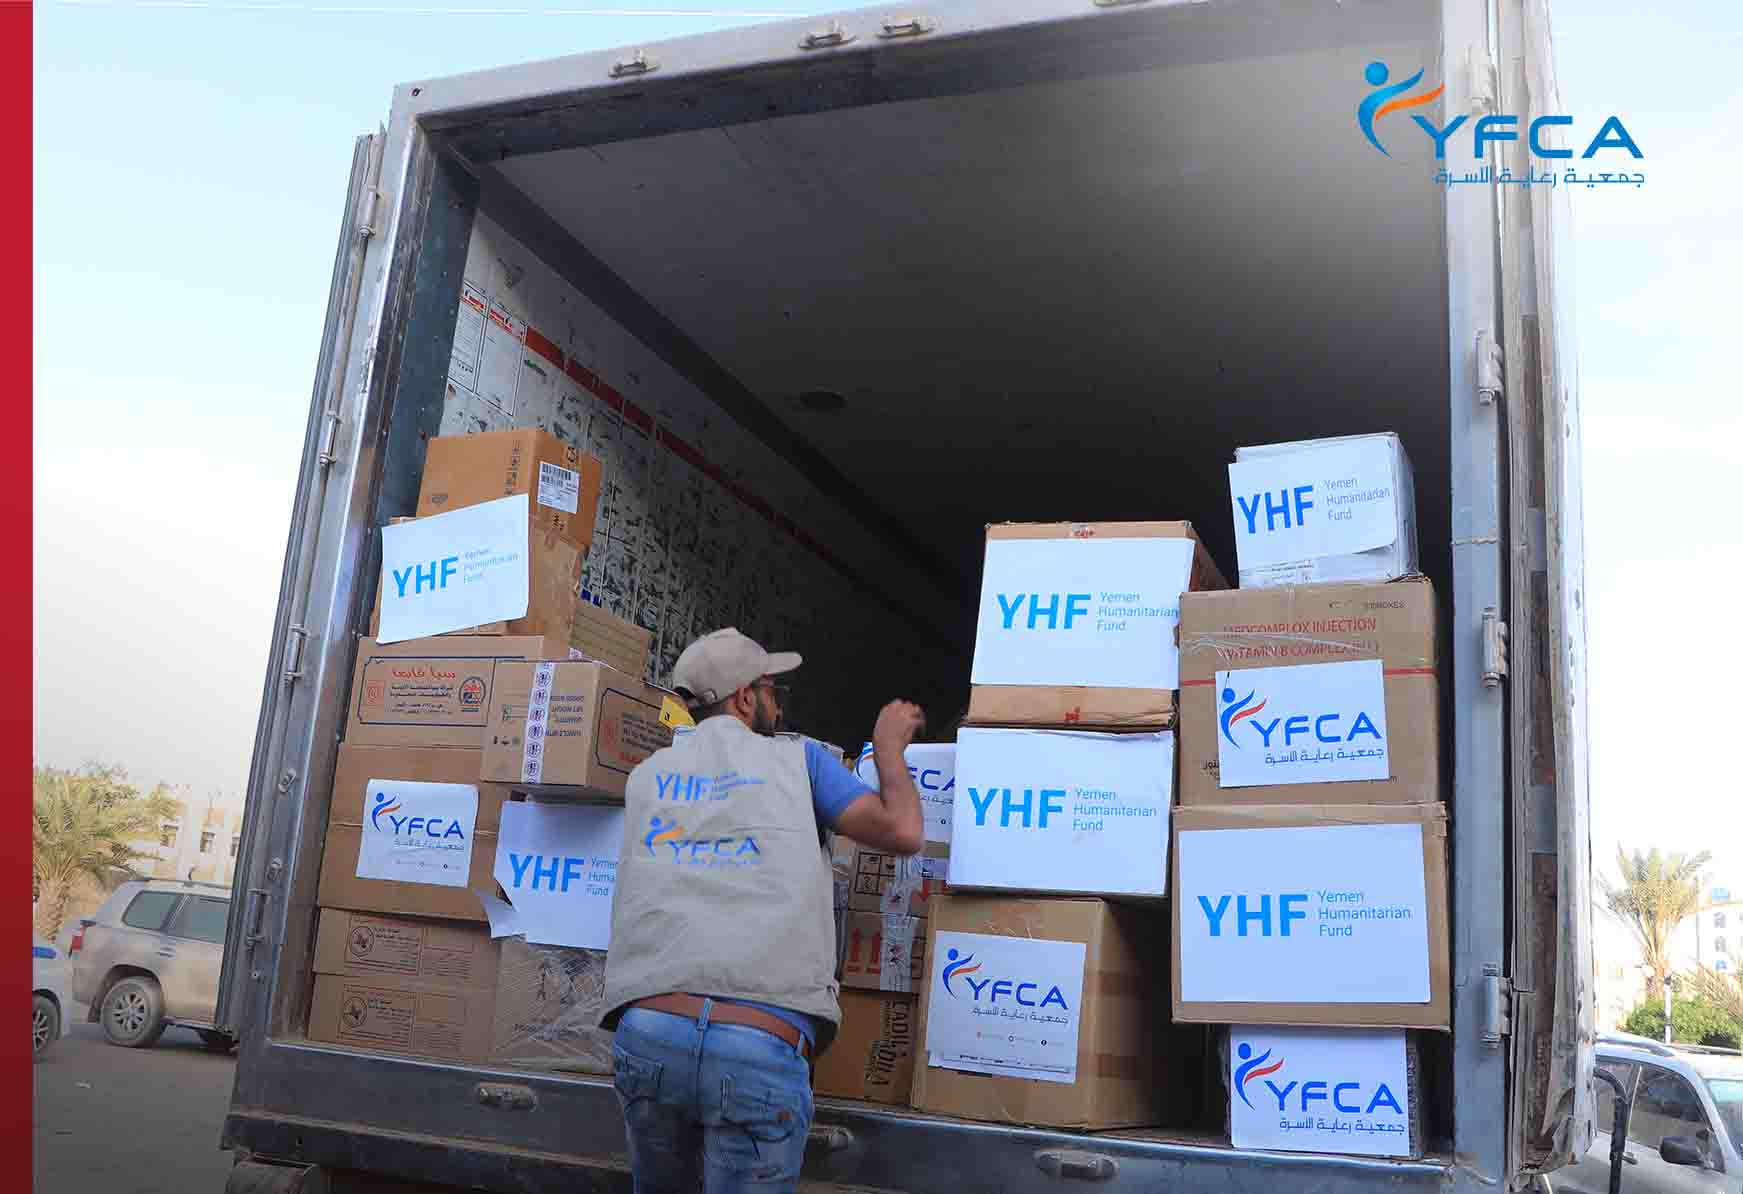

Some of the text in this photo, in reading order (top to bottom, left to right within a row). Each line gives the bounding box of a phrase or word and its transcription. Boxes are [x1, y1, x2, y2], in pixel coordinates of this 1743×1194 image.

[1325, 478, 1357, 489] Yemen
[1327, 488, 1390, 505] Humanitarian
[1237, 485, 1313, 533] YHF
[1328, 509, 1352, 520] Fund
[393, 557, 459, 598] YHF
[1100, 592, 1139, 602] Yemen
[997, 594, 1091, 629] YHF
[1098, 607, 1178, 618] Humanitarian
[1097, 621, 1126, 632] Fund
[1312, 616, 1376, 632] INJECTION
[1250, 712, 1381, 747] YFCA
[1300, 749, 1333, 763] رعاية
[1337, 748, 1384, 760] جمعية
[656, 773, 714, 800] YHF
[1076, 789, 1115, 800] Yemen
[967, 788, 1066, 828] YHF
[1073, 805, 1157, 817] Humanitarian
[390, 816, 464, 839] YFCA
[1073, 820, 1103, 831] Fund
[667, 837, 760, 858] YFCA
[510, 854, 584, 892] YHF
[1318, 890, 1363, 903] Yemen
[1198, 894, 1308, 937] YHF
[1319, 907, 1410, 920] Humanitarian
[1319, 925, 1352, 937] Fund
[966, 977, 1068, 1010] YFCA
[1264, 1080, 1403, 1114] YFCA
[1317, 1118, 1351, 1133] رعاية
[1355, 1119, 1404, 1135] جمعية
